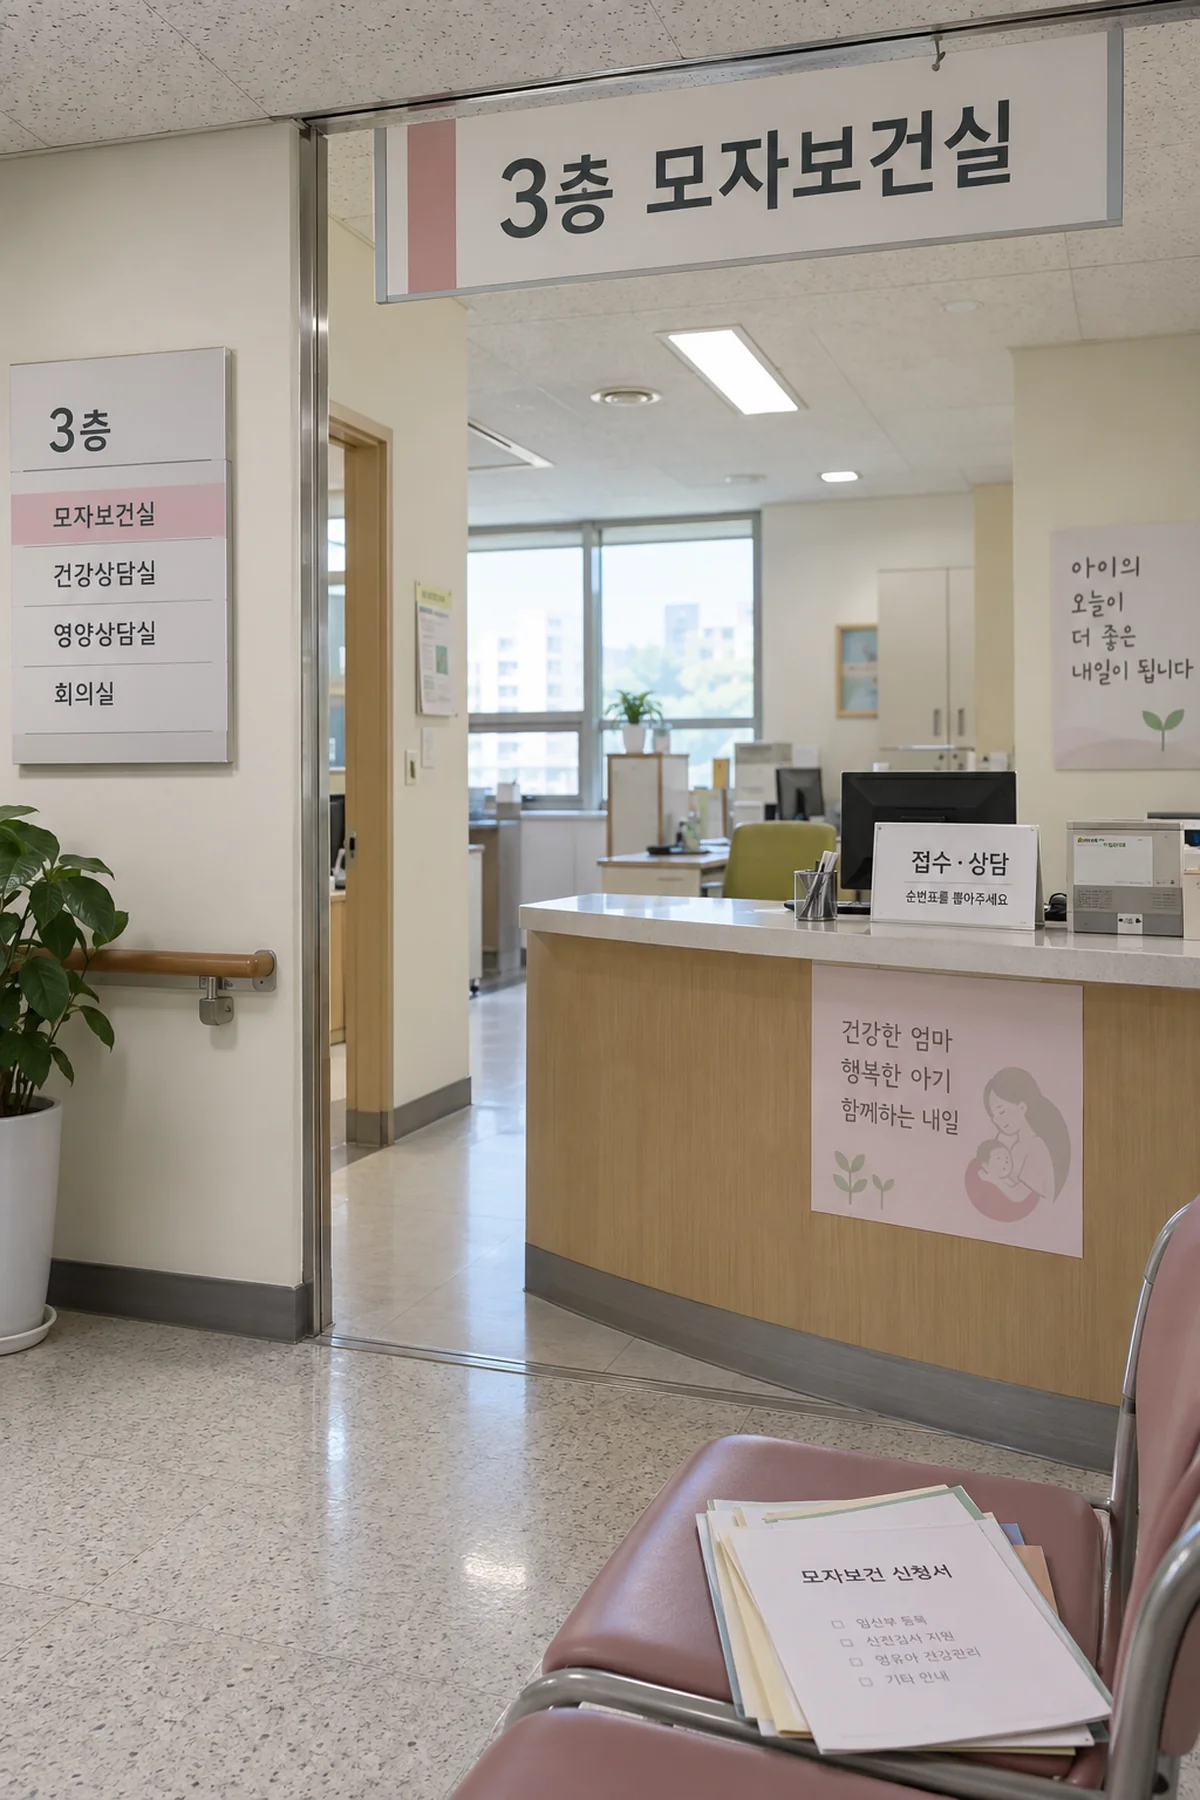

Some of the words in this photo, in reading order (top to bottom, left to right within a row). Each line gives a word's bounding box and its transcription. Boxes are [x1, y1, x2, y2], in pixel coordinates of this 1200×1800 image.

[500, 154, 613, 238] 3층
[647, 100, 1010, 213] 모자보건실
[50, 408, 111, 452] 3층
[54, 502, 154, 528] 모자보건실
[54, 560, 155, 587] 건강상담실
[1072, 556, 1139, 578] 아이의
[1072, 590, 1122, 617] 오늘이
[54, 621, 155, 648] 영양상담실
[1072, 628, 1089, 647] 더
[1102, 625, 1136, 651] 좋은
[1073, 659, 1127, 685] 내일이
[1138, 658, 1194, 684] 됩니다
[55, 682, 113, 706] 회의실
[912, 851, 951, 874] 접수
[969, 852, 1009, 876] 상담
[906, 890, 948, 904] 순번표를
[843, 1020, 901, 1048] 건강한
[912, 1027, 953, 1053] 엄마
[841, 1058, 901, 1088] 행복한
[911, 1067, 949, 1093] 아기
[841, 1098, 915, 1129] 함께하는
[923, 1109, 957, 1135] 내일
[801, 1567, 886, 1584] 모자보건
[892, 1563, 953, 1582] 신청서
[918, 1670, 950, 1684] 안내
